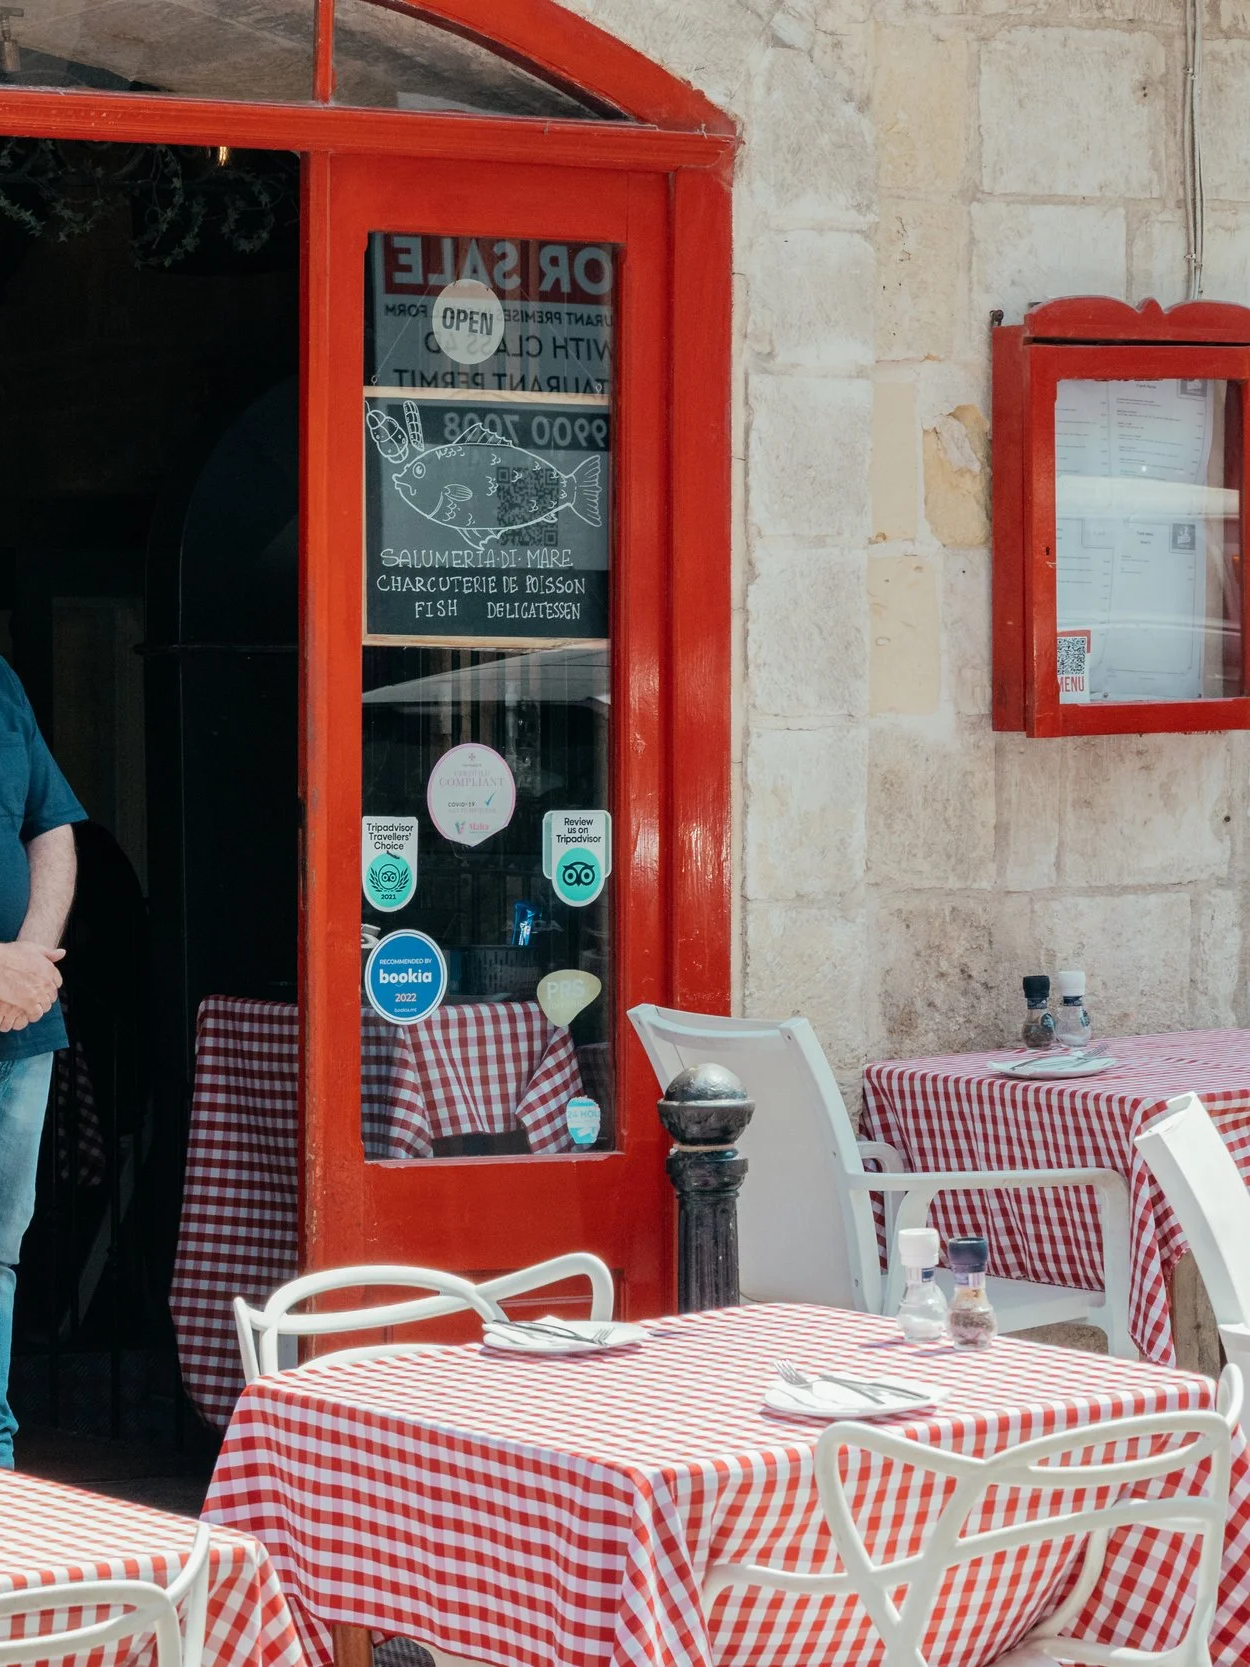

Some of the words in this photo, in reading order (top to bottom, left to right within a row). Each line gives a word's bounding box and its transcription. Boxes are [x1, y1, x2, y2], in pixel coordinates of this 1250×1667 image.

[442, 307, 493, 336] OPEN
[380, 548, 497, 569] SALUMERIA
[527, 548, 574, 569] MARE
[376, 574, 498, 594] CHARCUTERIE
[503, 576, 519, 594] DE
[526, 575, 586, 595] POISSON
[415, 600, 458, 619] FISH
[487, 601, 581, 620] DELICATESSEN
[439, 777, 505, 787] COMPLIANT
[564, 816, 594, 826] Review
[366, 822, 414, 834] Tripadvisor
[578, 826, 589, 834] on
[373, 841, 404, 850] Choice
[556, 834, 602, 845] Tripadvisor
[379, 968, 432, 984] bookia
[546, 979, 586, 1000] PRS
[394, 993, 417, 1002] 2022
